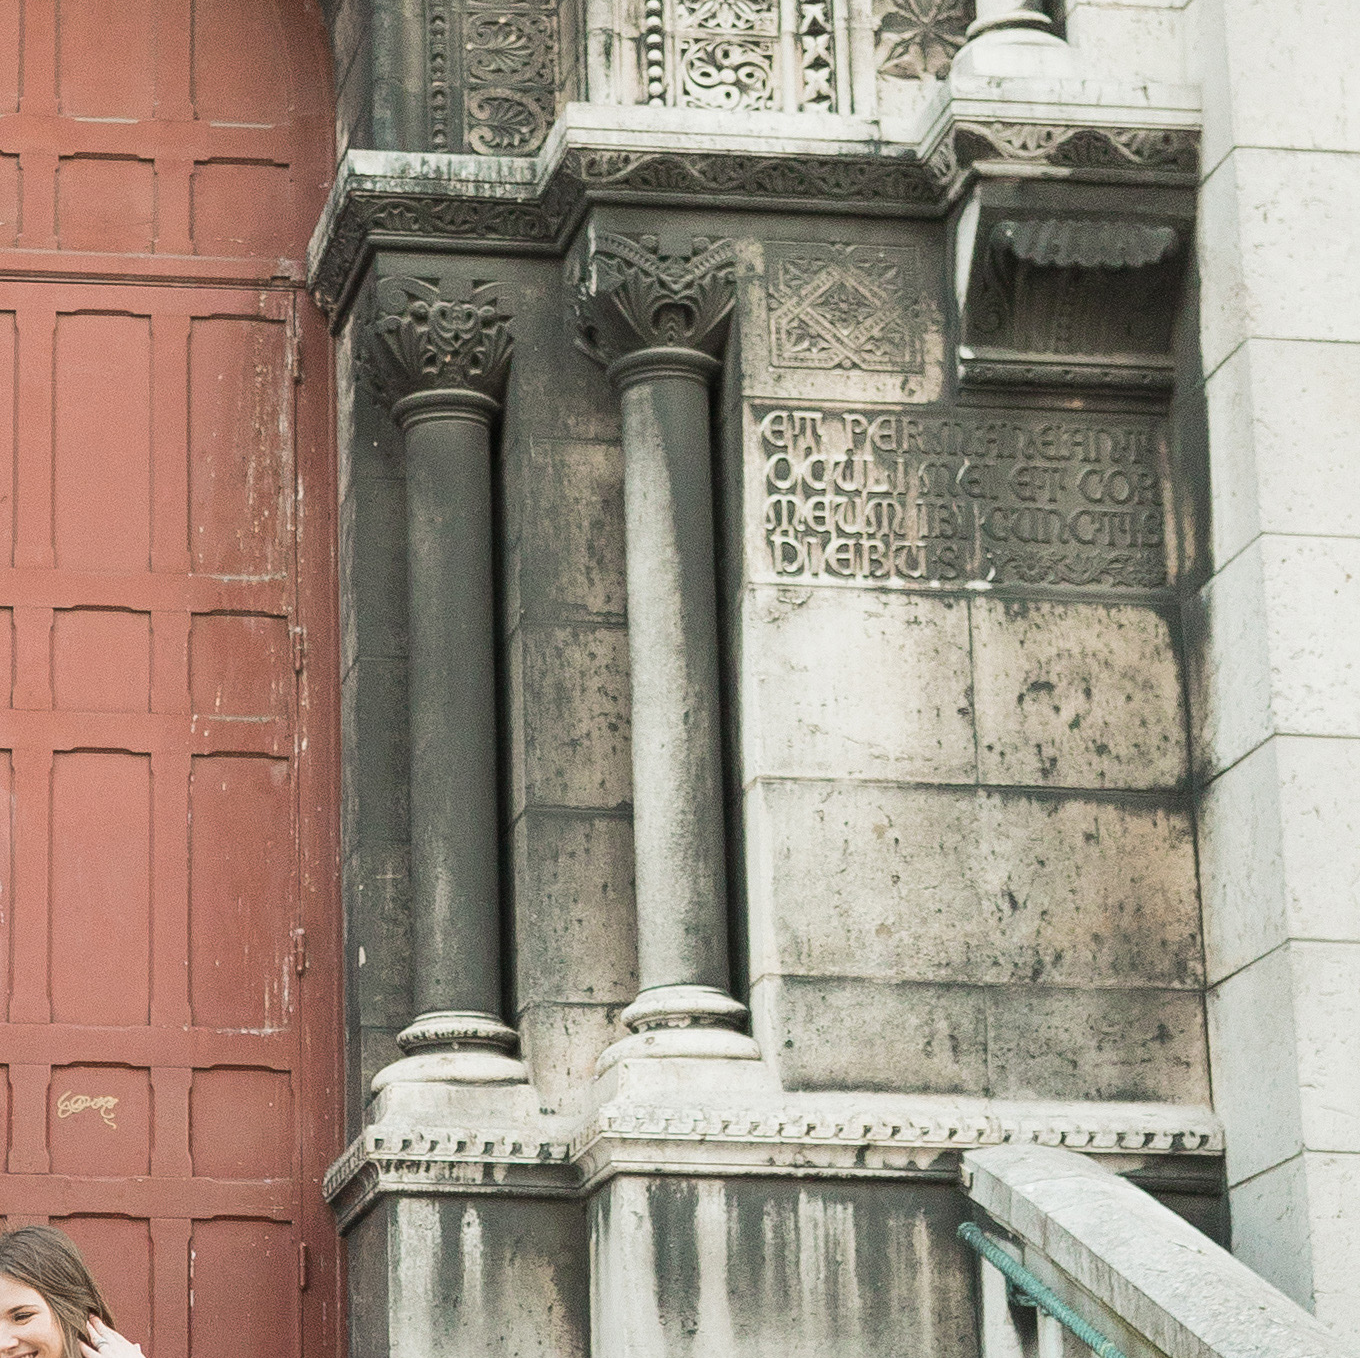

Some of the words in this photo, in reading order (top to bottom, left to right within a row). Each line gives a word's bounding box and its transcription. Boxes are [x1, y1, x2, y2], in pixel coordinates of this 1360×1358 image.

[760, 409, 823, 448] ET
[841, 411, 1152, 465] PERMANEANT
[764, 451, 907, 496] OCULI
[917, 458, 999, 501] MEI
[1008, 463, 1067, 503] ET
[1076, 465, 1162, 506] COR
[763, 493, 907, 538] MEUM
[915, 499, 969, 540] IBI
[770, 531, 962, 580] DIEBUS
